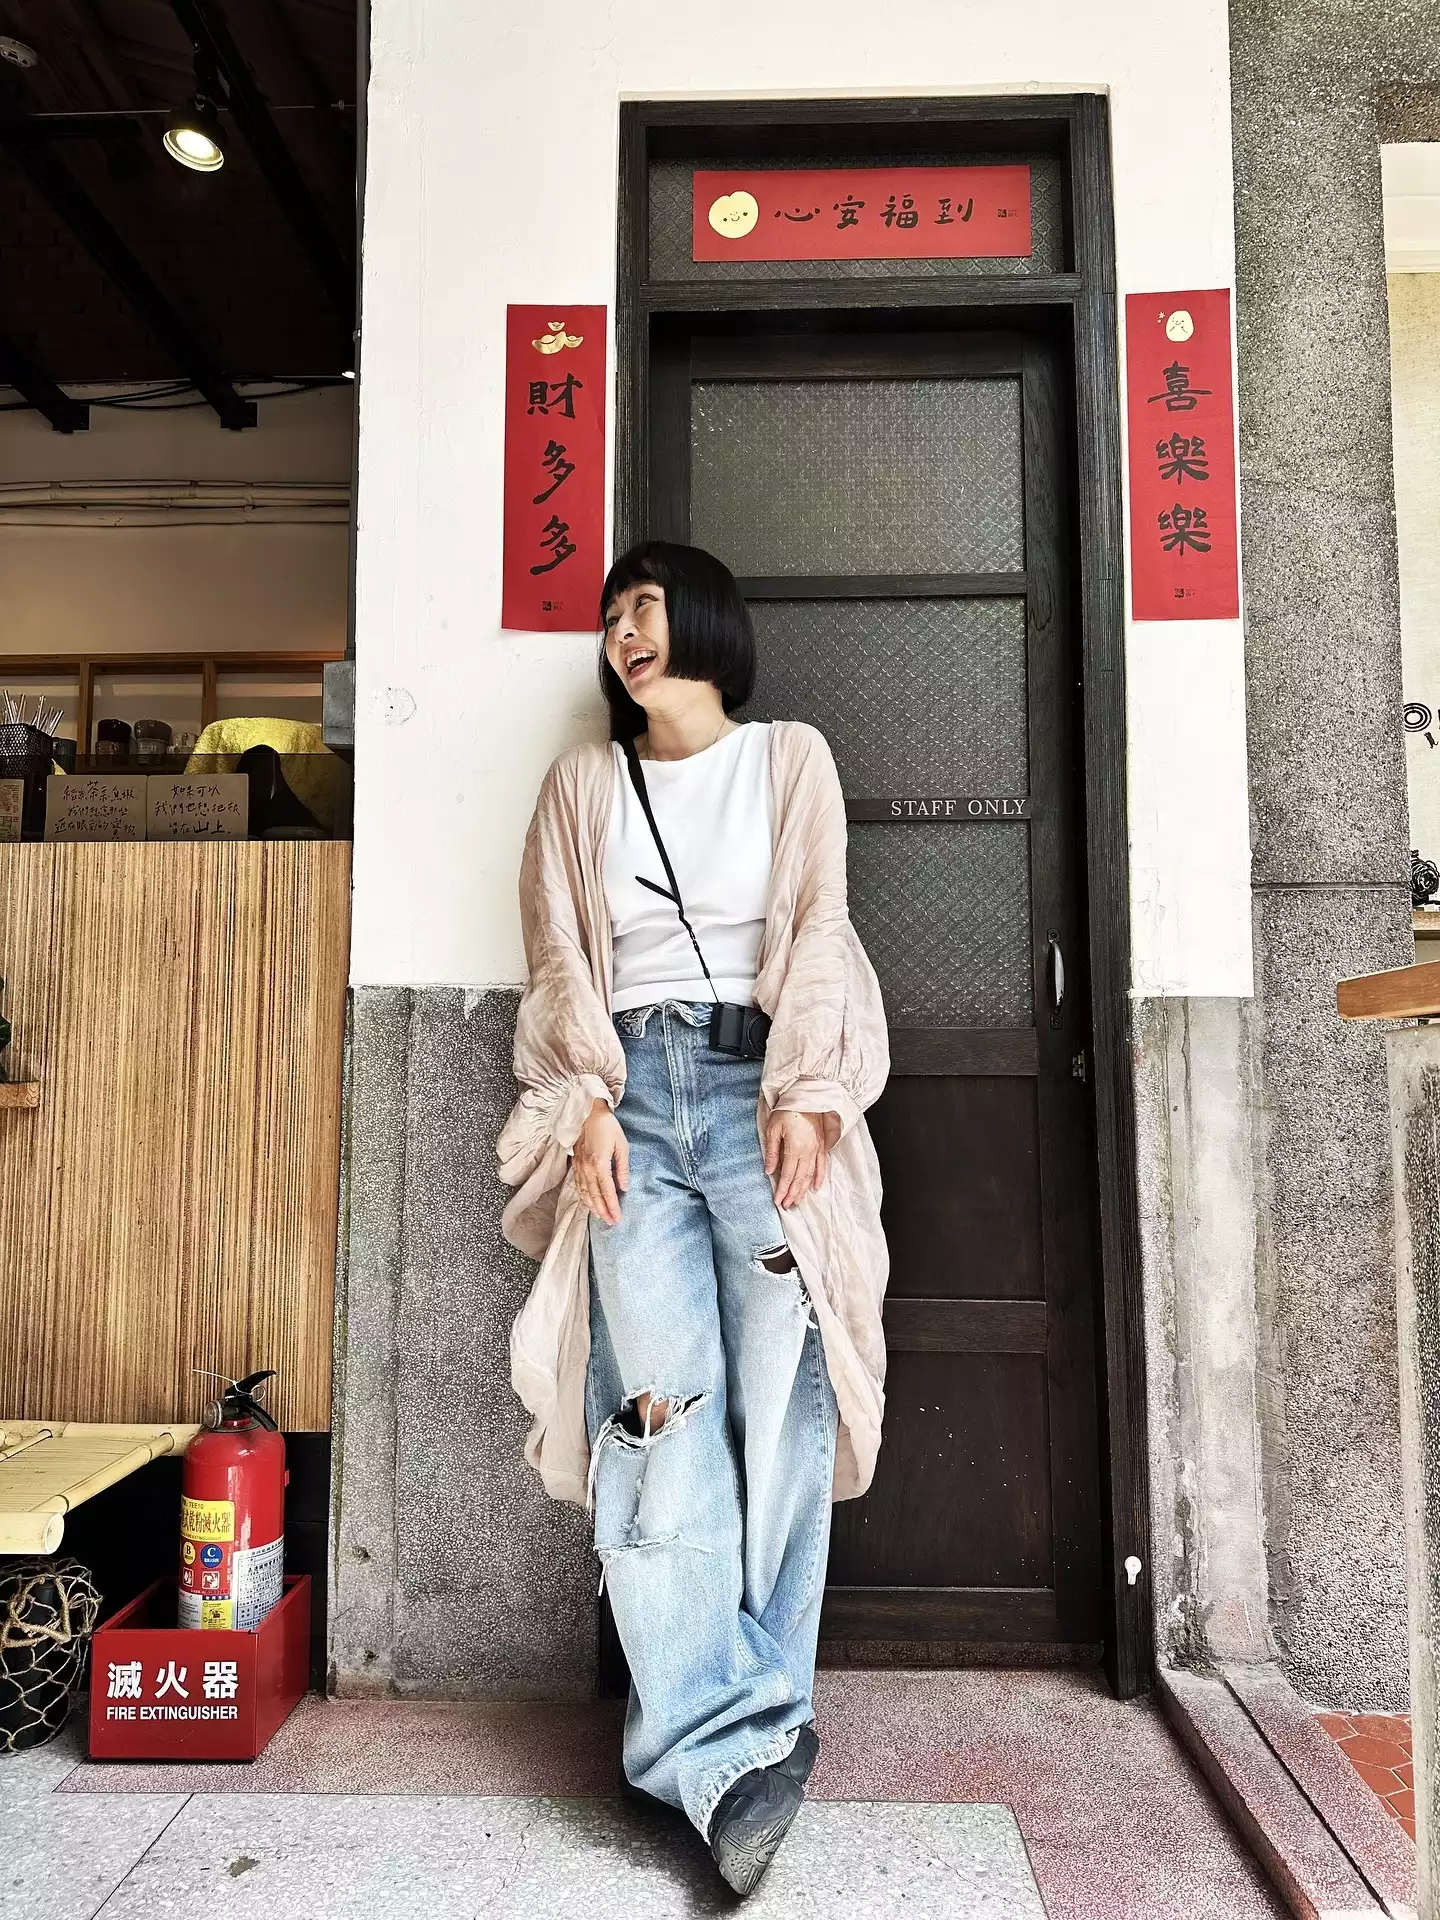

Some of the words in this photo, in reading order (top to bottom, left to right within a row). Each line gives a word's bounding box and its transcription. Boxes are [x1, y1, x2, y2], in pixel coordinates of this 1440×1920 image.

[773, 194, 974, 229] 心安福到
[1147, 360, 1212, 556] 喜樂樂
[527, 372, 584, 576] 財多多
[170, 784, 221, 799] 如果可以
[891, 800, 957, 816] STAFF
[967, 799, 1026, 815] ONLY
[181, 1508, 232, 1534] 式乾粉滅火器
[186, 1545, 192, 1555] B
[207, 1547, 216, 1557] C
[106, 1660, 239, 1699] 滅火器
[106, 1706, 137, 1720] FIRE
[139, 1706, 238, 1720] EXTINGUISHER
